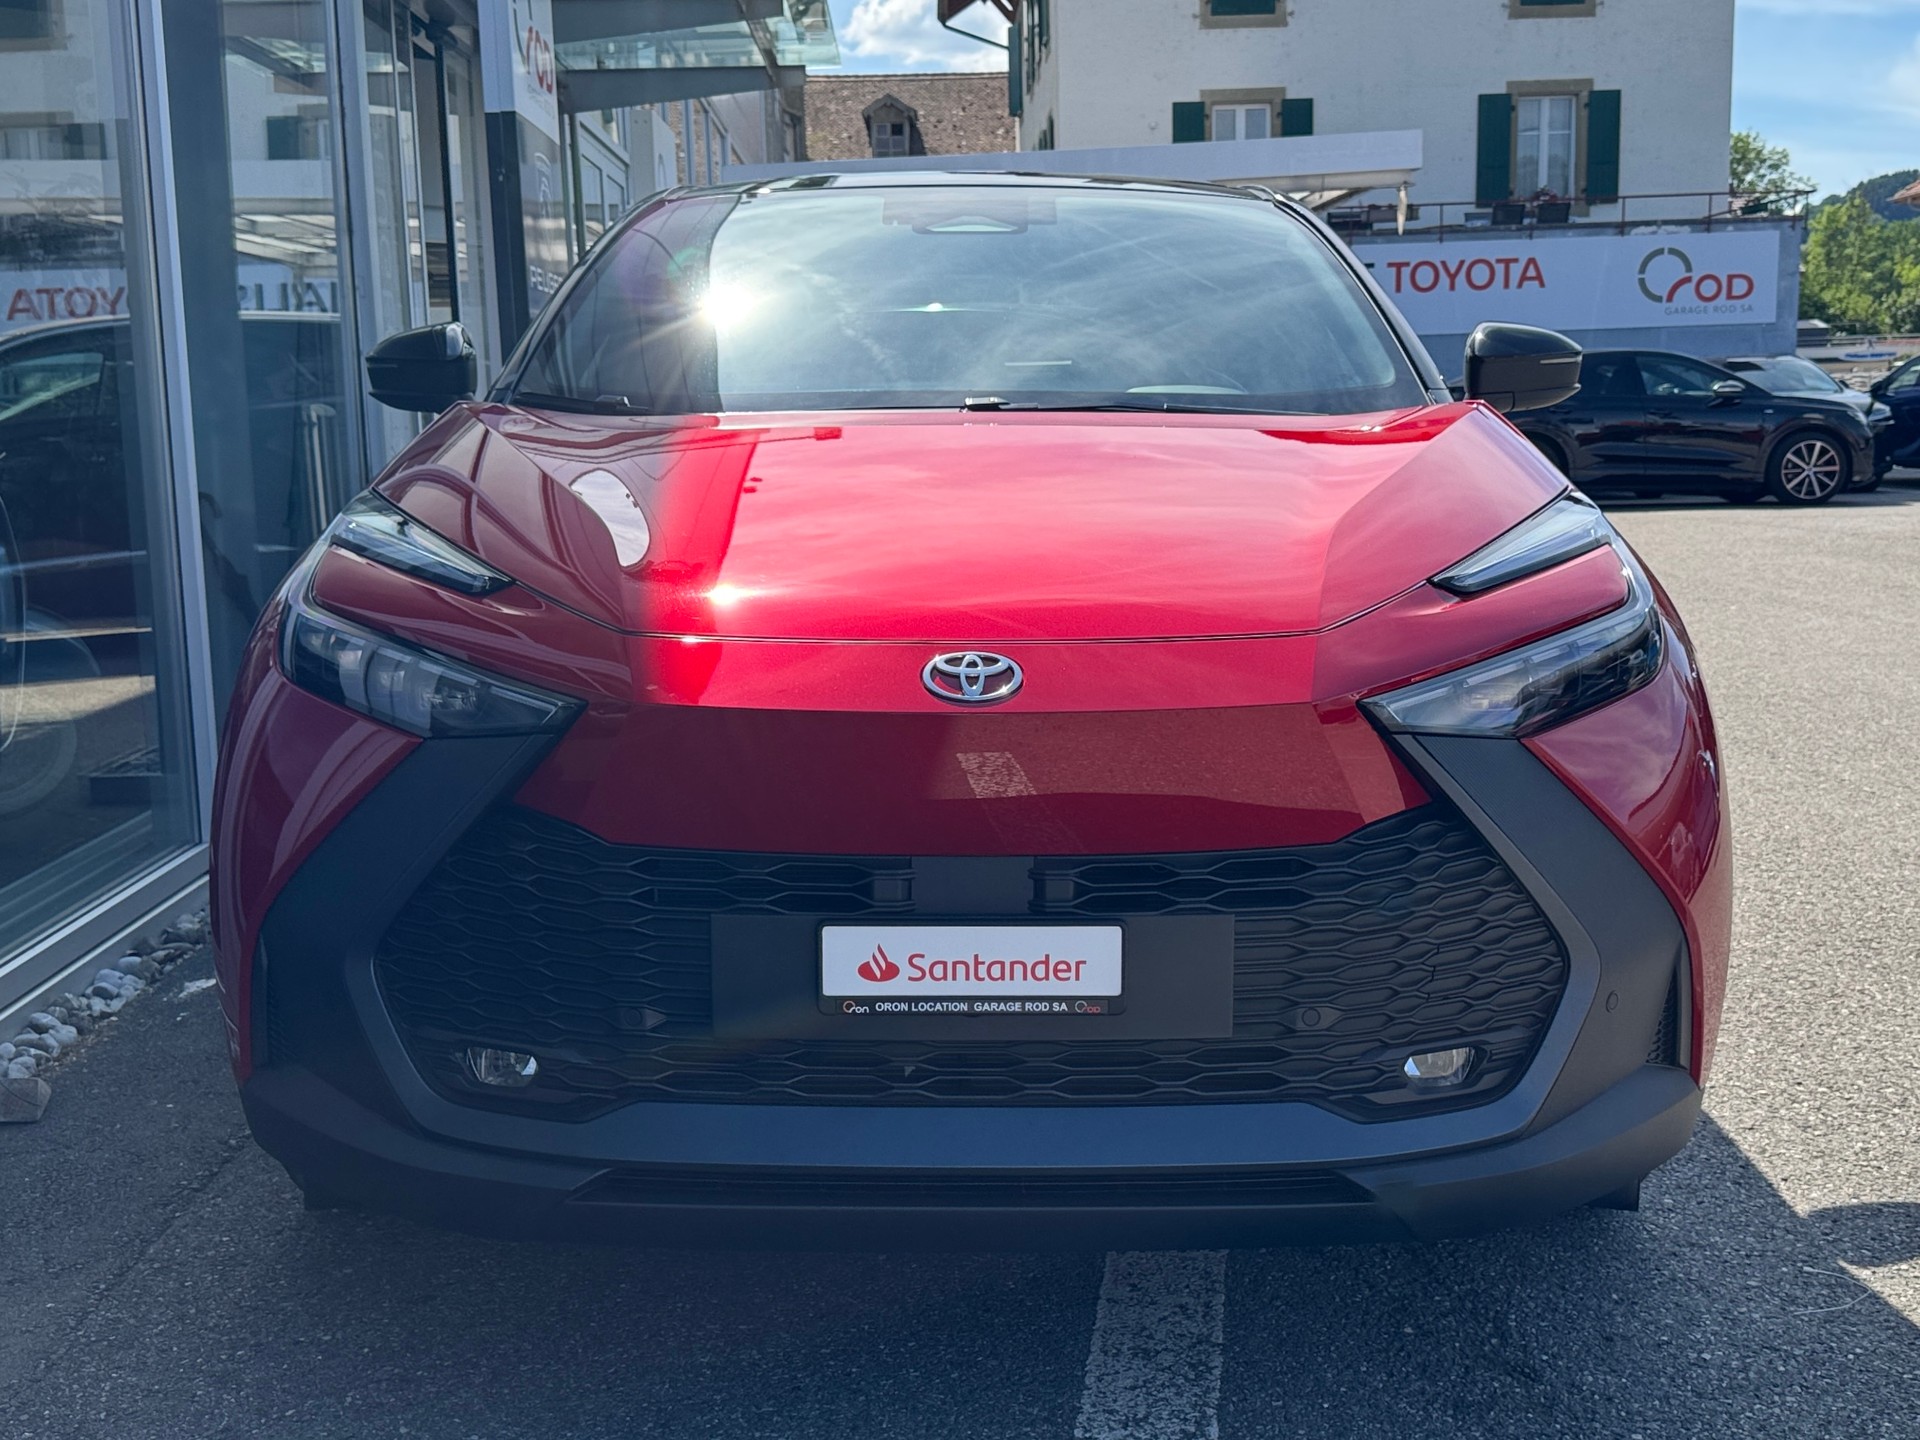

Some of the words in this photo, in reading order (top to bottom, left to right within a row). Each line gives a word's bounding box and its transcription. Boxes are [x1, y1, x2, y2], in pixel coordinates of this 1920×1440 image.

[1387, 257, 1545, 294] TOYOTA
[1664, 305, 1708, 316] GARAGE
[1712, 304, 1737, 314] ROD
[1740, 304, 1754, 313] SA
[907, 953, 1087, 982] Santander
[875, 1002, 909, 1012] ORON
[911, 1002, 968, 1012] LOCATION
[973, 1002, 1023, 1012] GARAGE
[1025, 1002, 1050, 1012] ROD
[1052, 1002, 1069, 1012] SA
